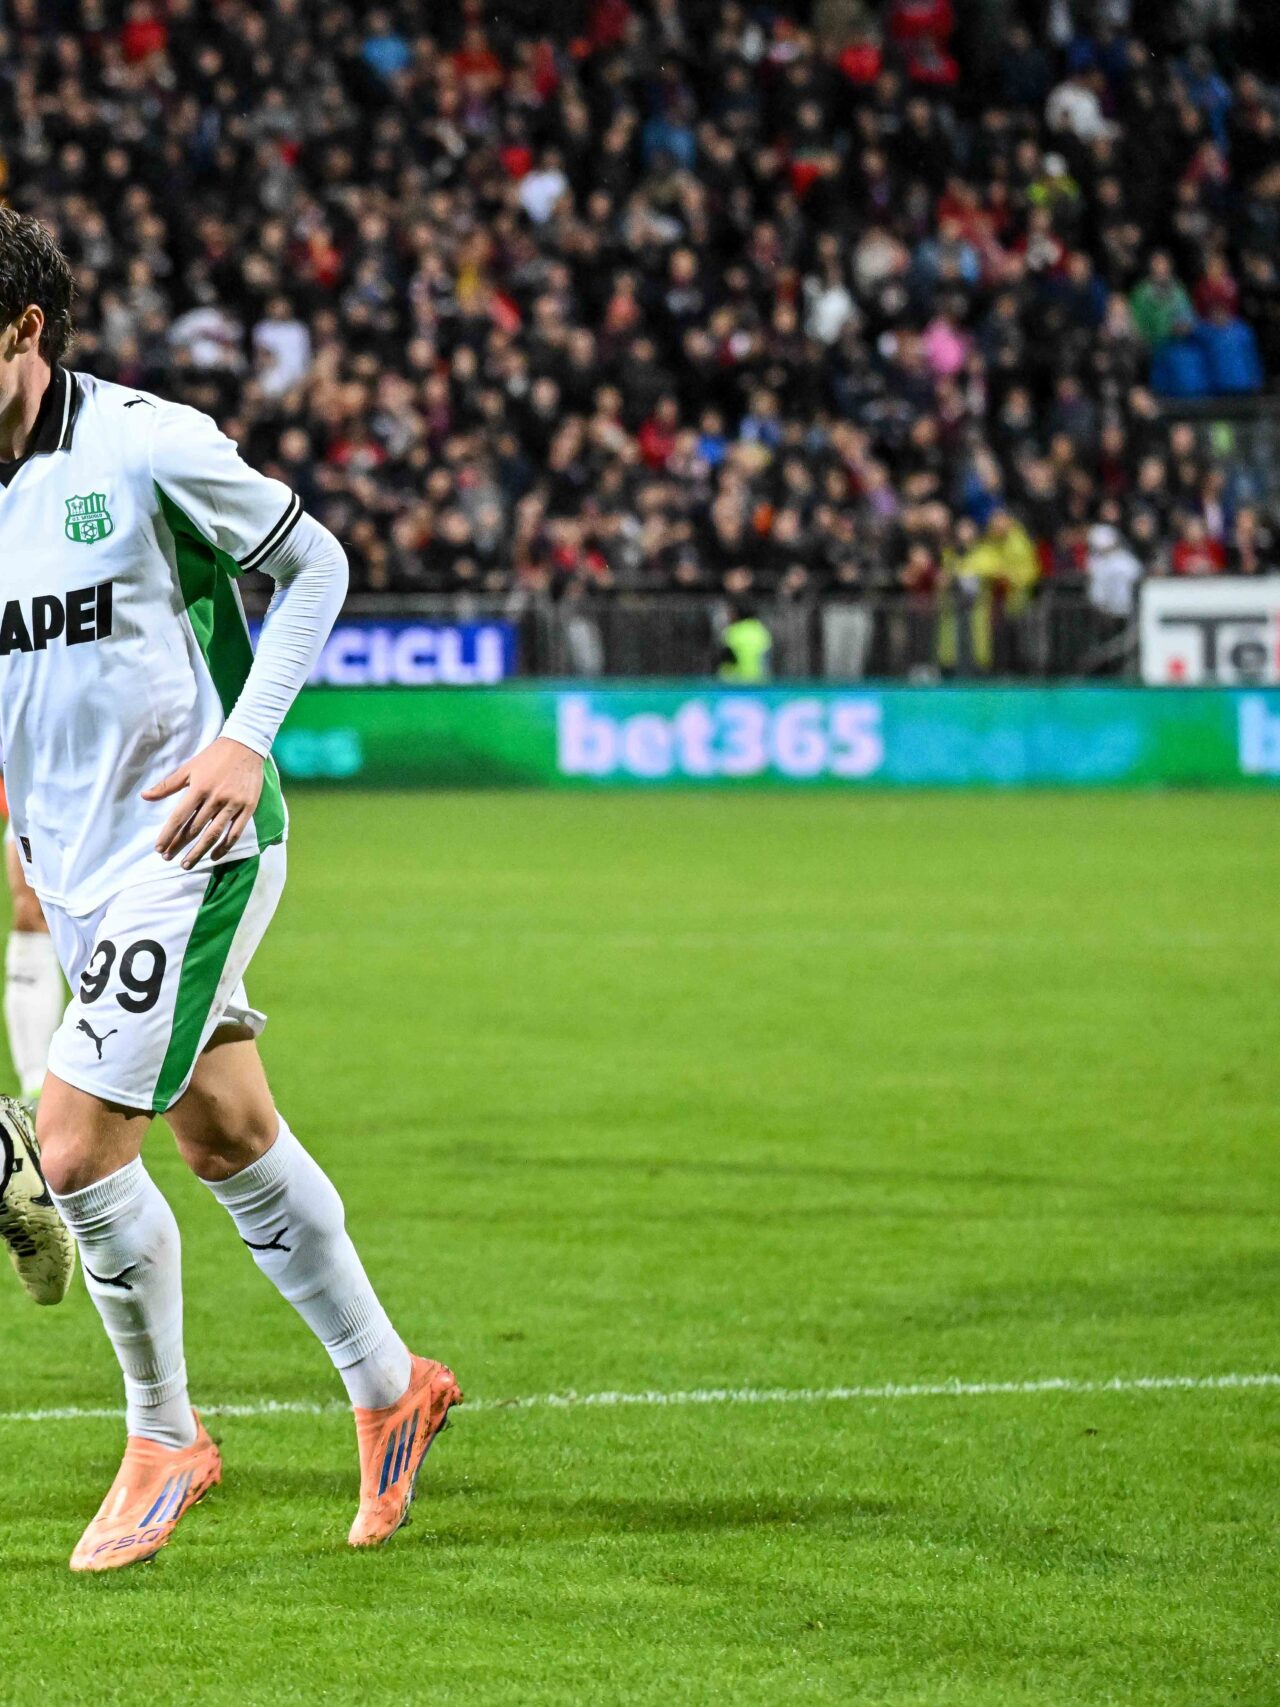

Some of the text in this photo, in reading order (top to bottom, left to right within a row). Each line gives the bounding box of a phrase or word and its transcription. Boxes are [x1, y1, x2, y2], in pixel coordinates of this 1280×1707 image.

[305, 626, 504, 686] CICLI
[557, 692, 883, 776] bet365
[80, 939, 167, 1013] 99
